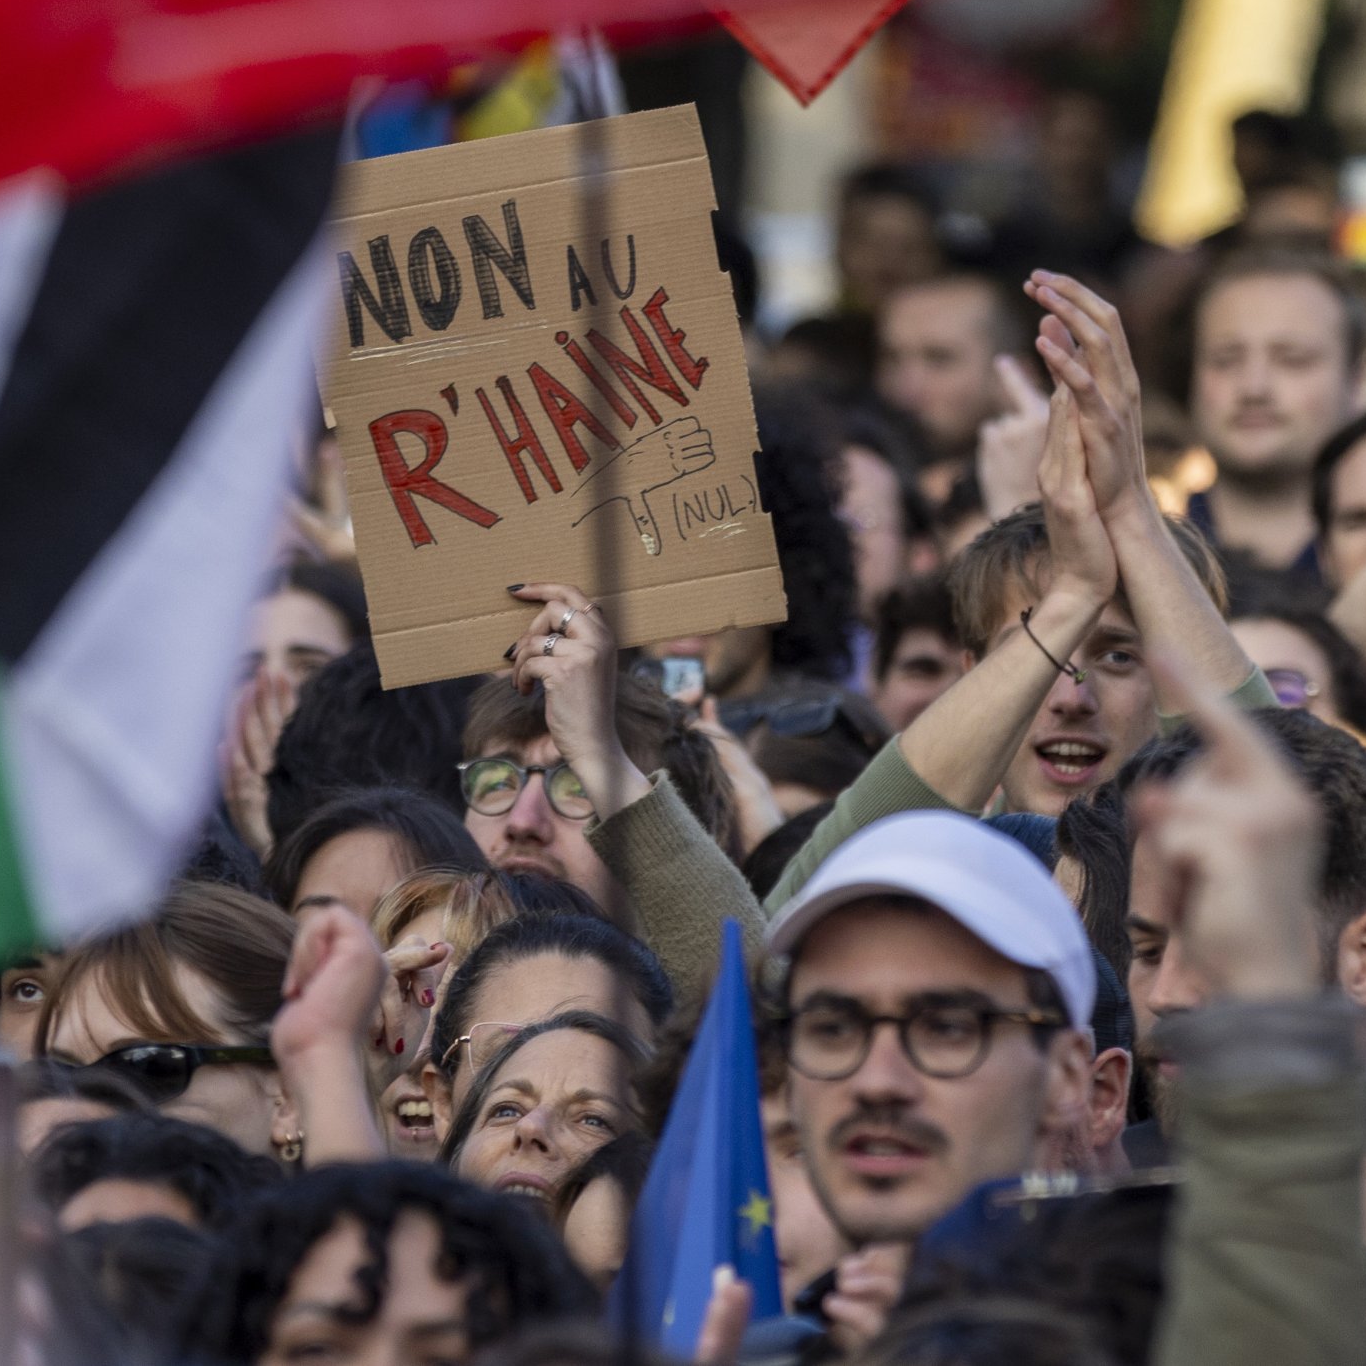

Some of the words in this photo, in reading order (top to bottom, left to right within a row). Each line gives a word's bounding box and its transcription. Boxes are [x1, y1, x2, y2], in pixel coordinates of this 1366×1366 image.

[337, 198, 535, 347] NON
[566, 234, 636, 311] AU
[671, 475, 759, 540] (NUL)
